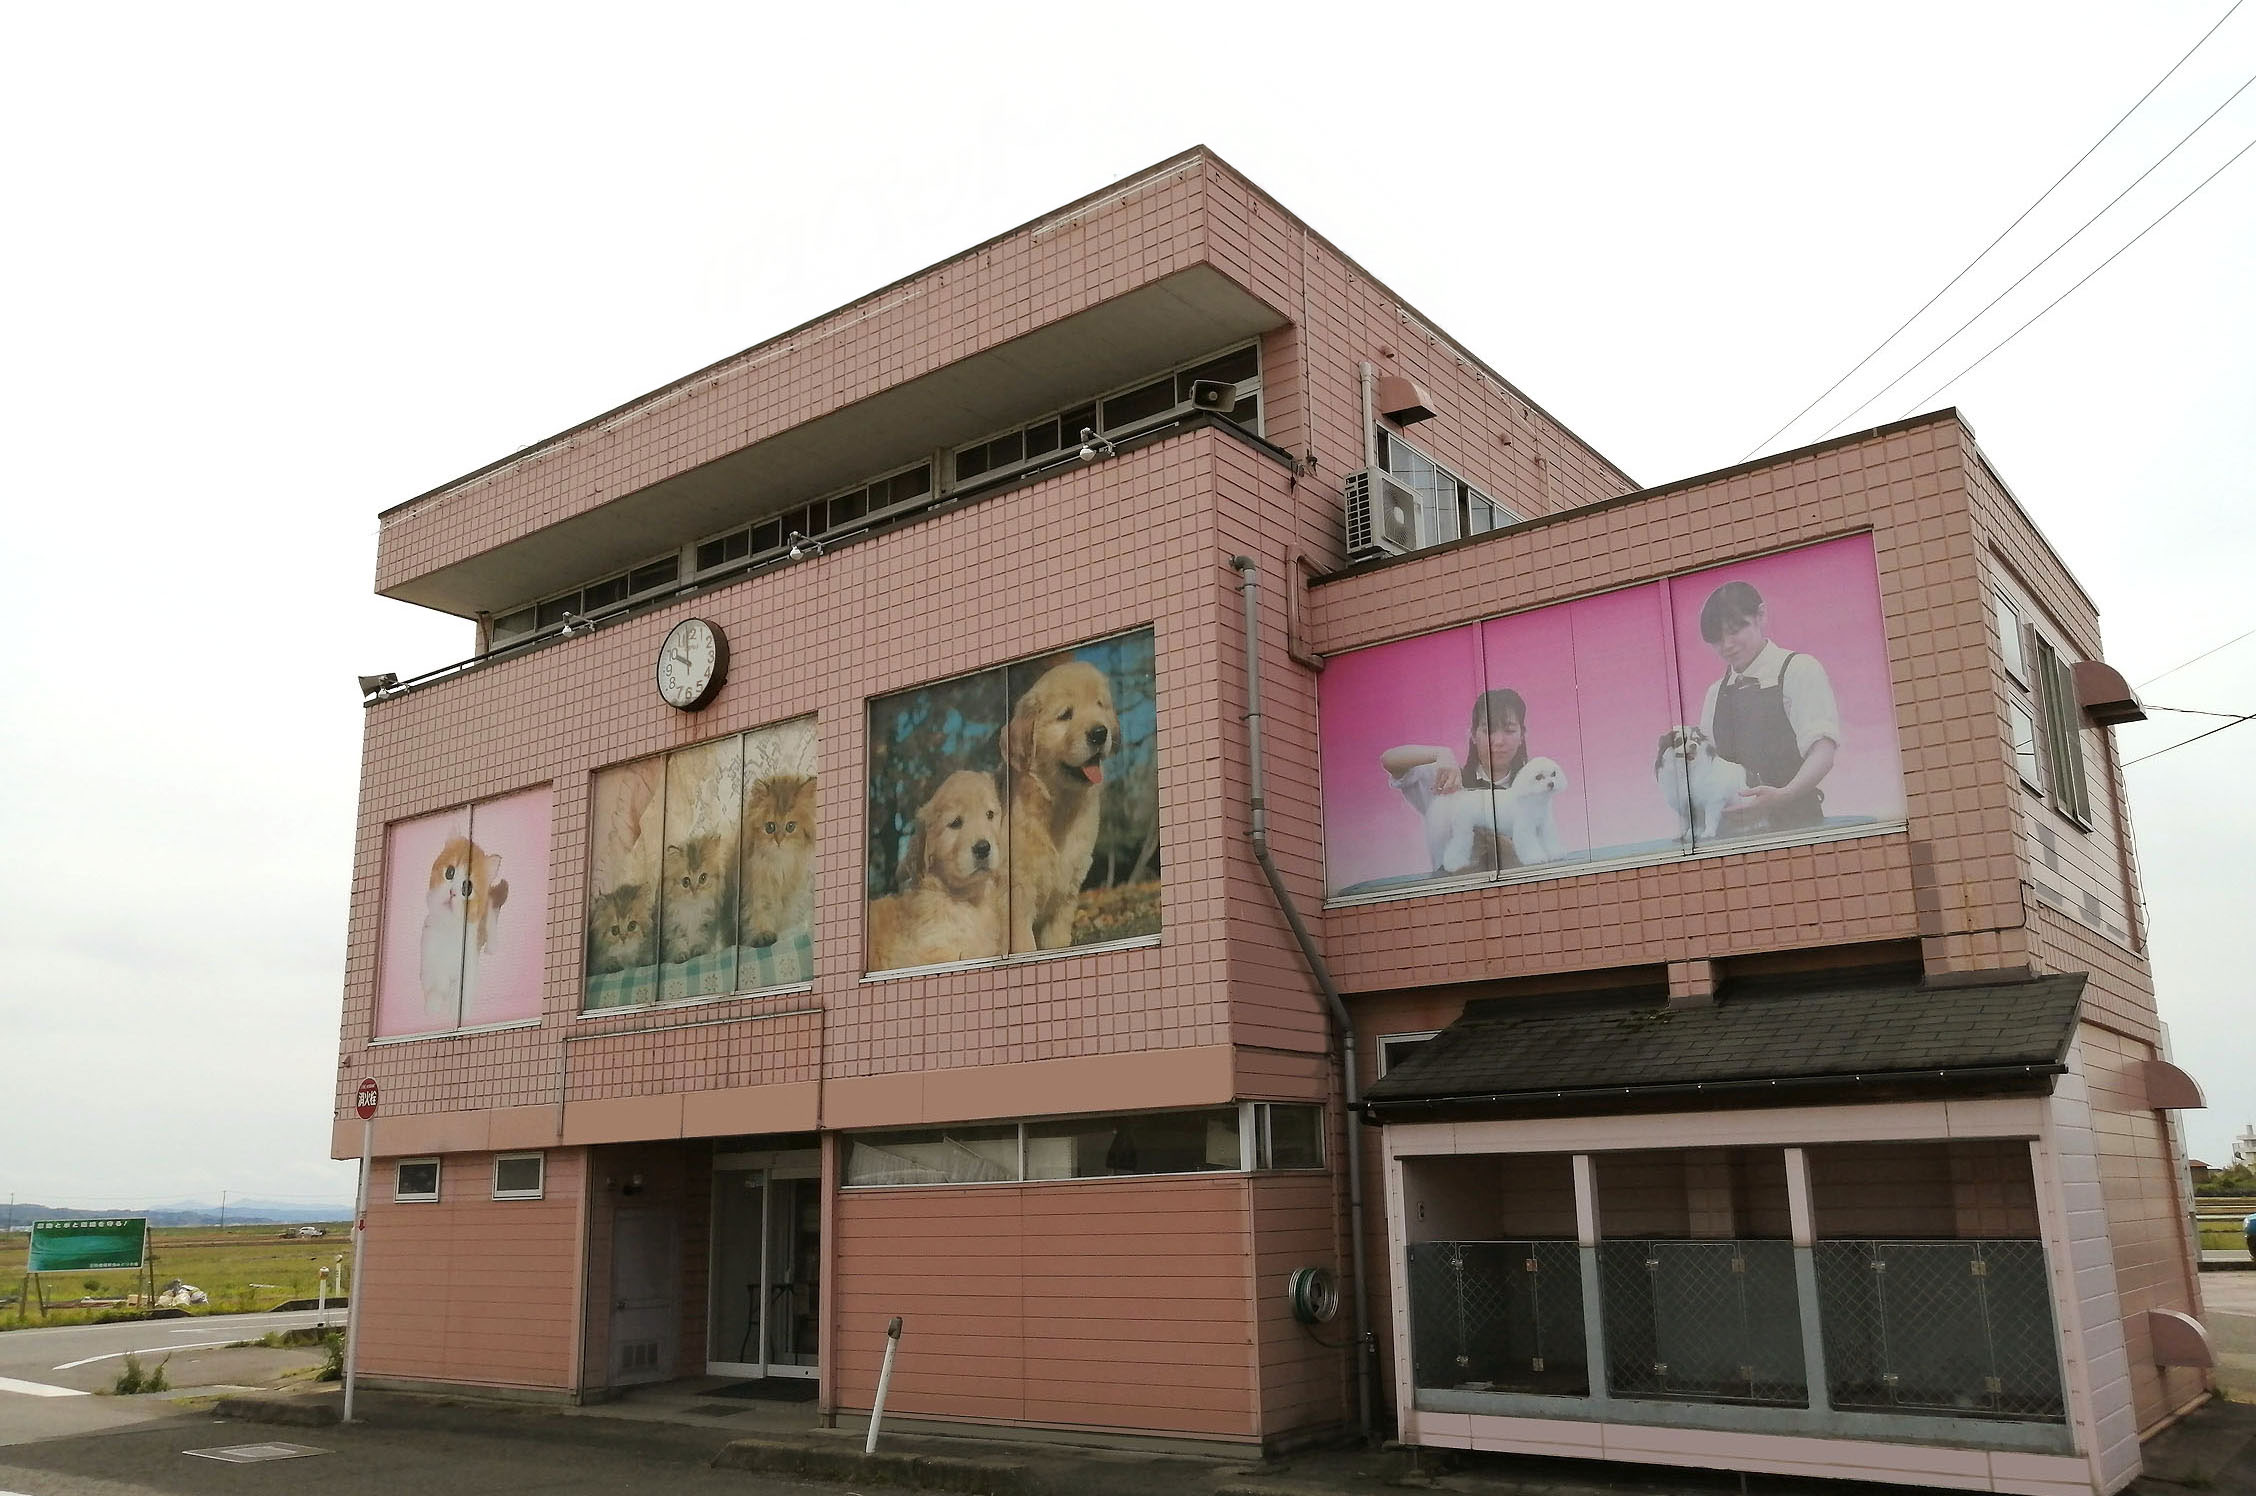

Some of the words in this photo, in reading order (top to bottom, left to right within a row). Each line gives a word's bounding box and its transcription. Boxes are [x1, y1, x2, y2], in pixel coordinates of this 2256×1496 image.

[706, 636, 713, 648] 2
[707, 650, 715, 664] 3
[666, 664, 673, 677] 9
[704, 667, 711, 678] 4
[669, 677, 676, 689] 8
[696, 681, 704, 692] 5
[676, 686, 684, 699] 7
[685, 687, 692, 699] 6
[358, 1091, 377, 1107] 消火栓
